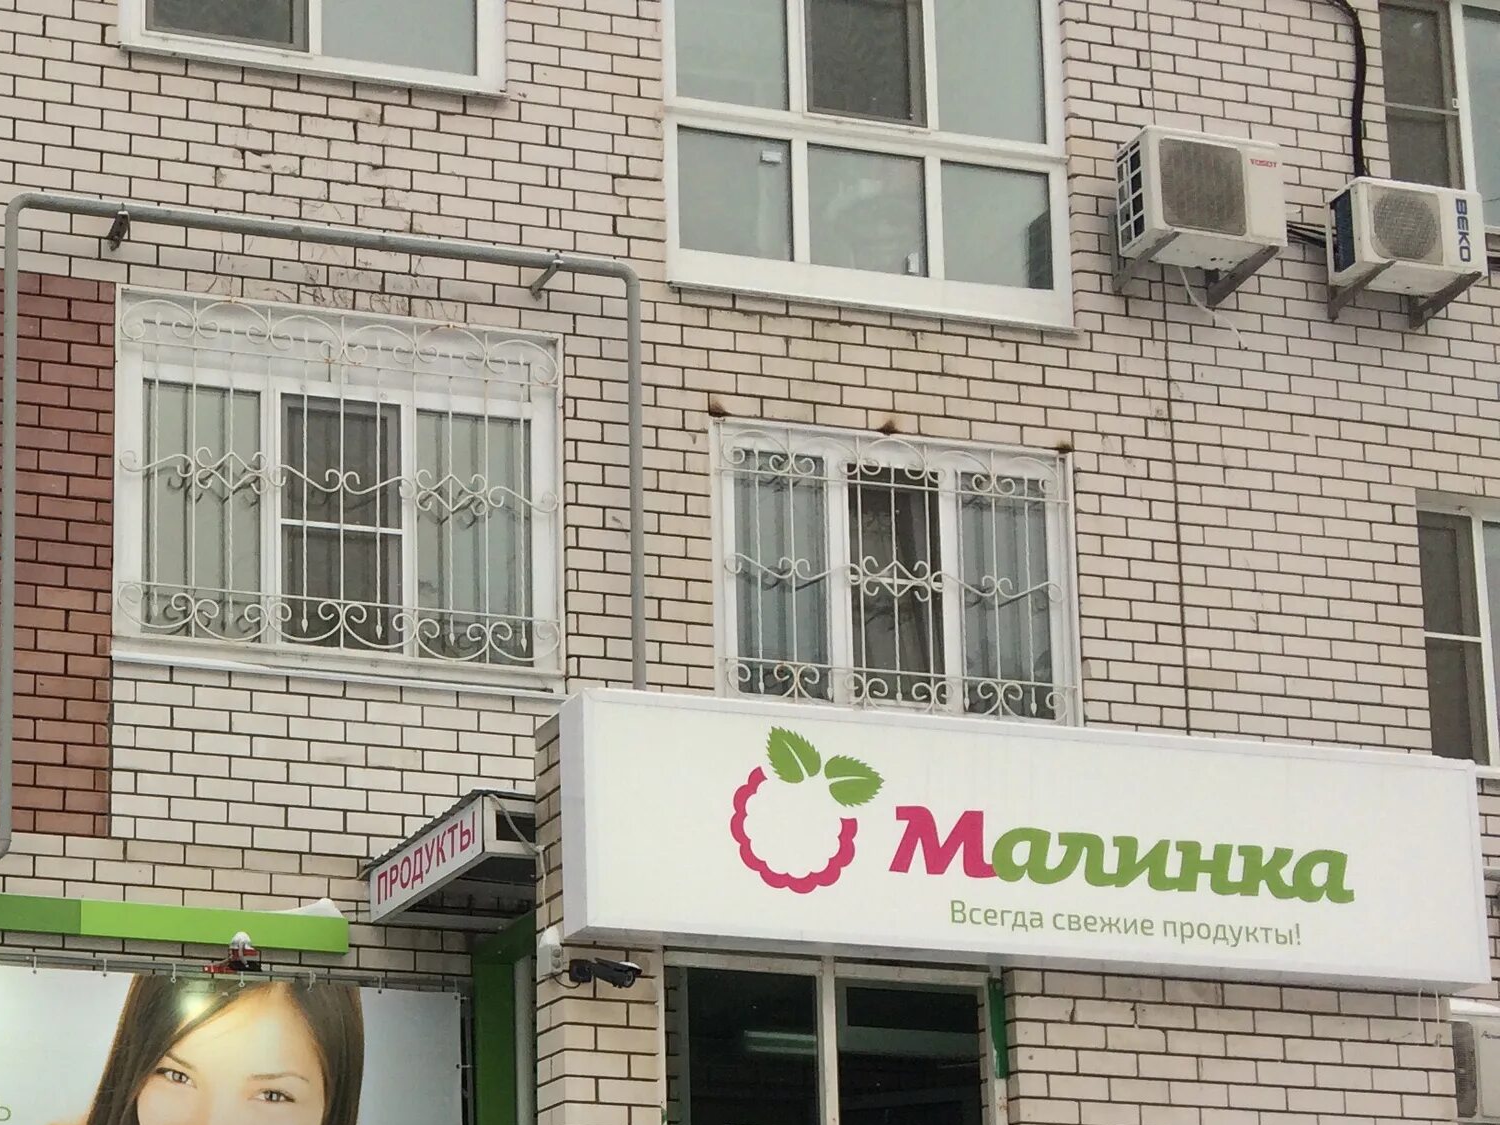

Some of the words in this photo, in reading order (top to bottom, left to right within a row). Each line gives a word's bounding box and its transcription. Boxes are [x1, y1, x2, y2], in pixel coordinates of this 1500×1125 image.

[1455, 198, 1472, 263] BEKO
[376, 811, 477, 905] ПРОДУКТЫ
[888, 804, 1355, 905] Малинка
[951, 899, 1044, 933] Всегда
[1052, 909, 1155, 938] свежие
[1162, 918, 1303, 948] продукты!
